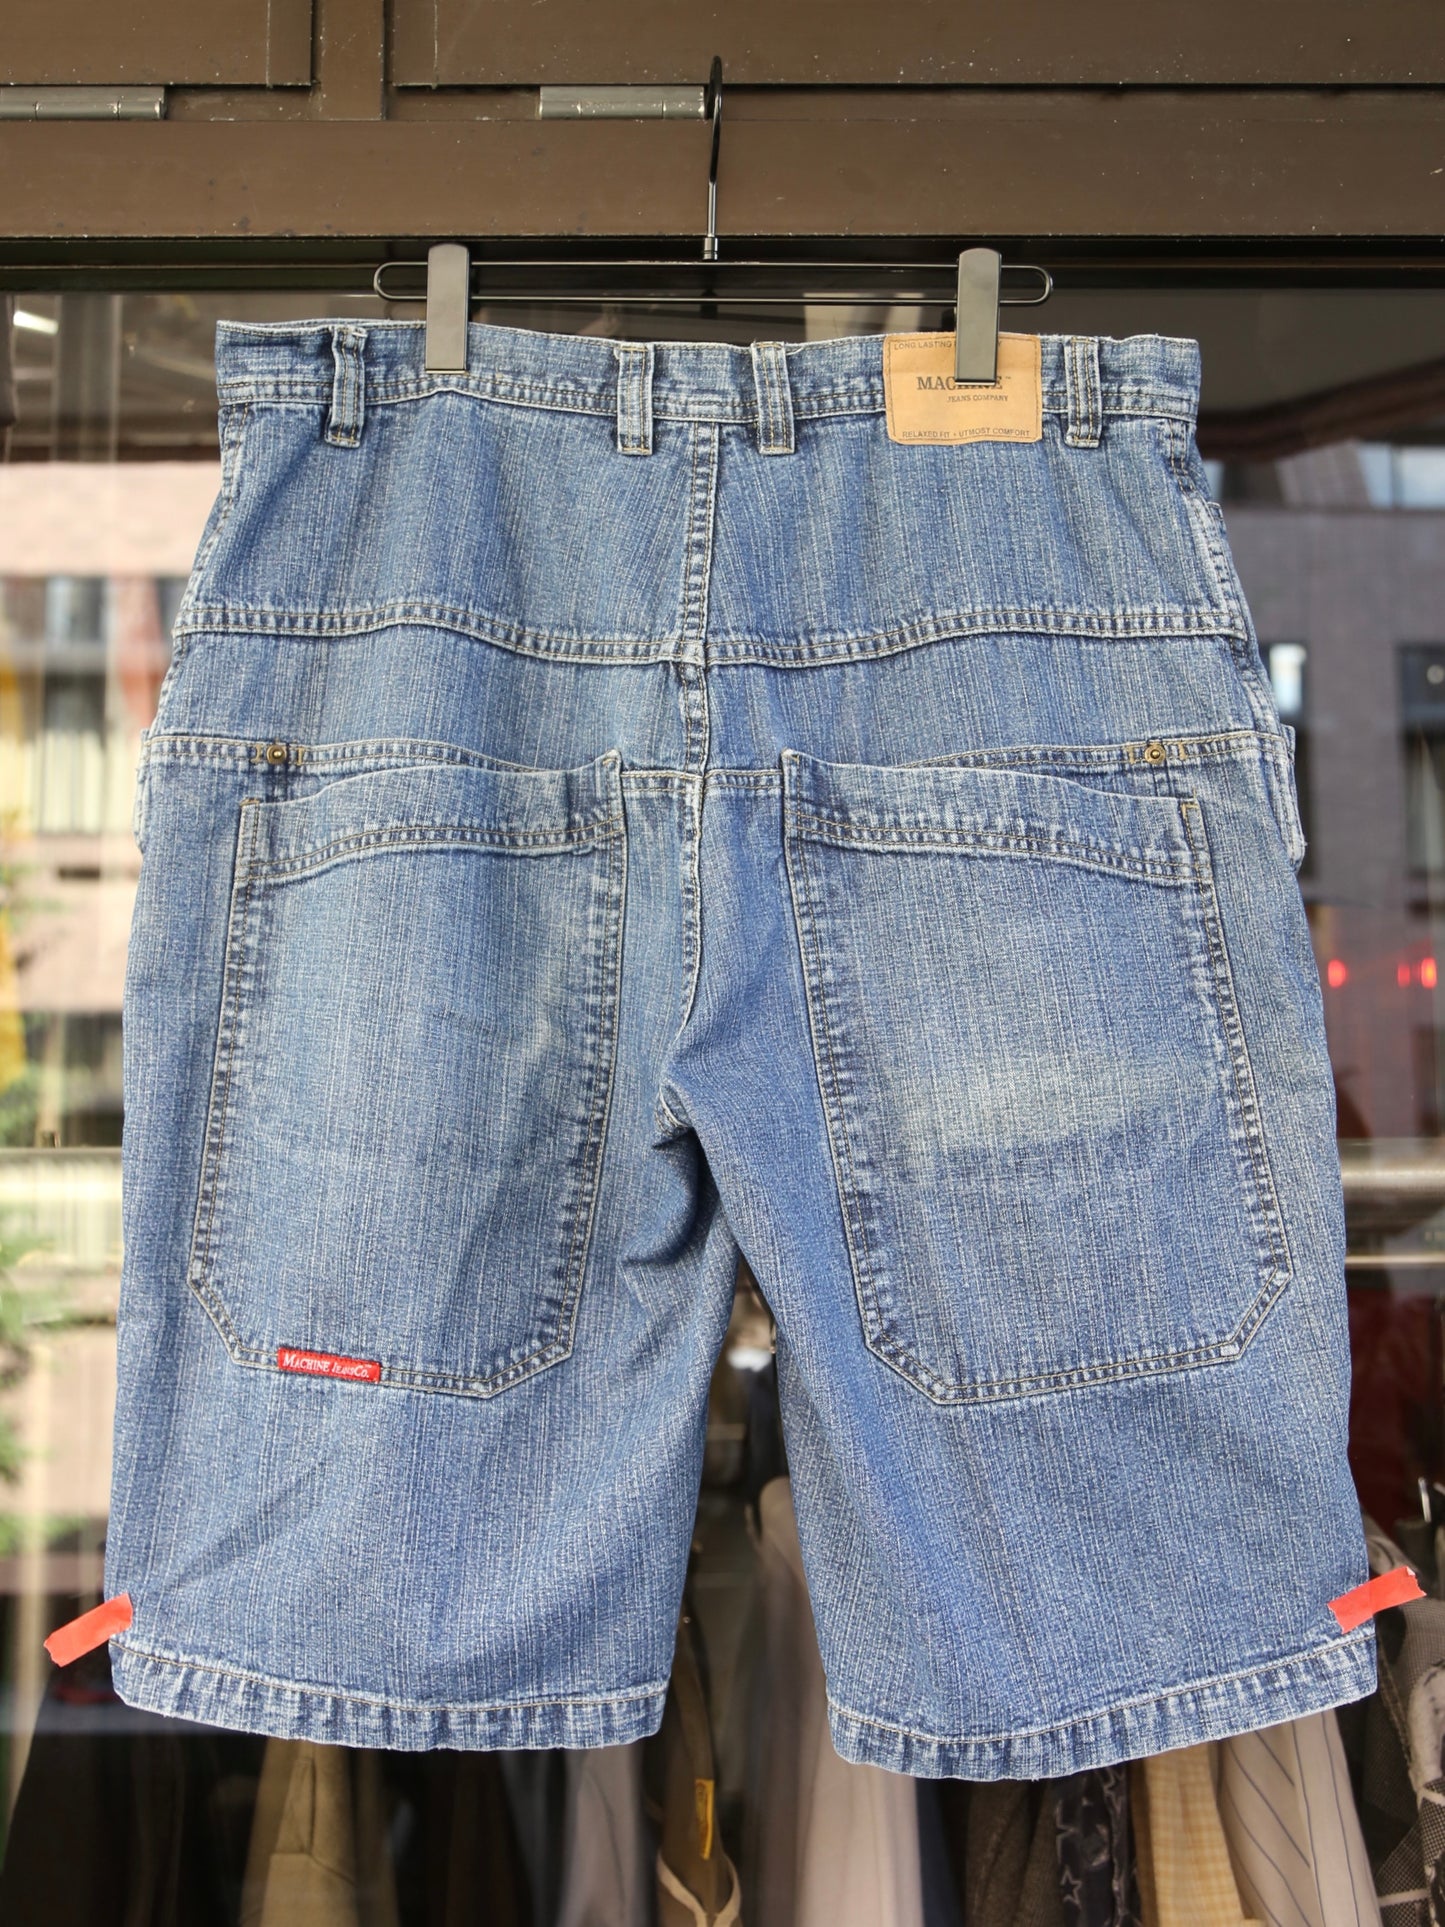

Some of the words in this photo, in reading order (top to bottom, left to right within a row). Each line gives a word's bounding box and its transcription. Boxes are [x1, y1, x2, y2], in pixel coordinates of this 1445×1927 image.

[894, 341, 917, 351] LONG
[918, 340, 953, 350] LASTING
[947, 394, 972, 403] JEANS
[972, 394, 1009, 403] COMPANY
[902, 430, 938, 438] RELAXED
[939, 430, 951, 438] FIT
[958, 427, 991, 437] UTMOST
[992, 427, 1031, 437] COMFORT
